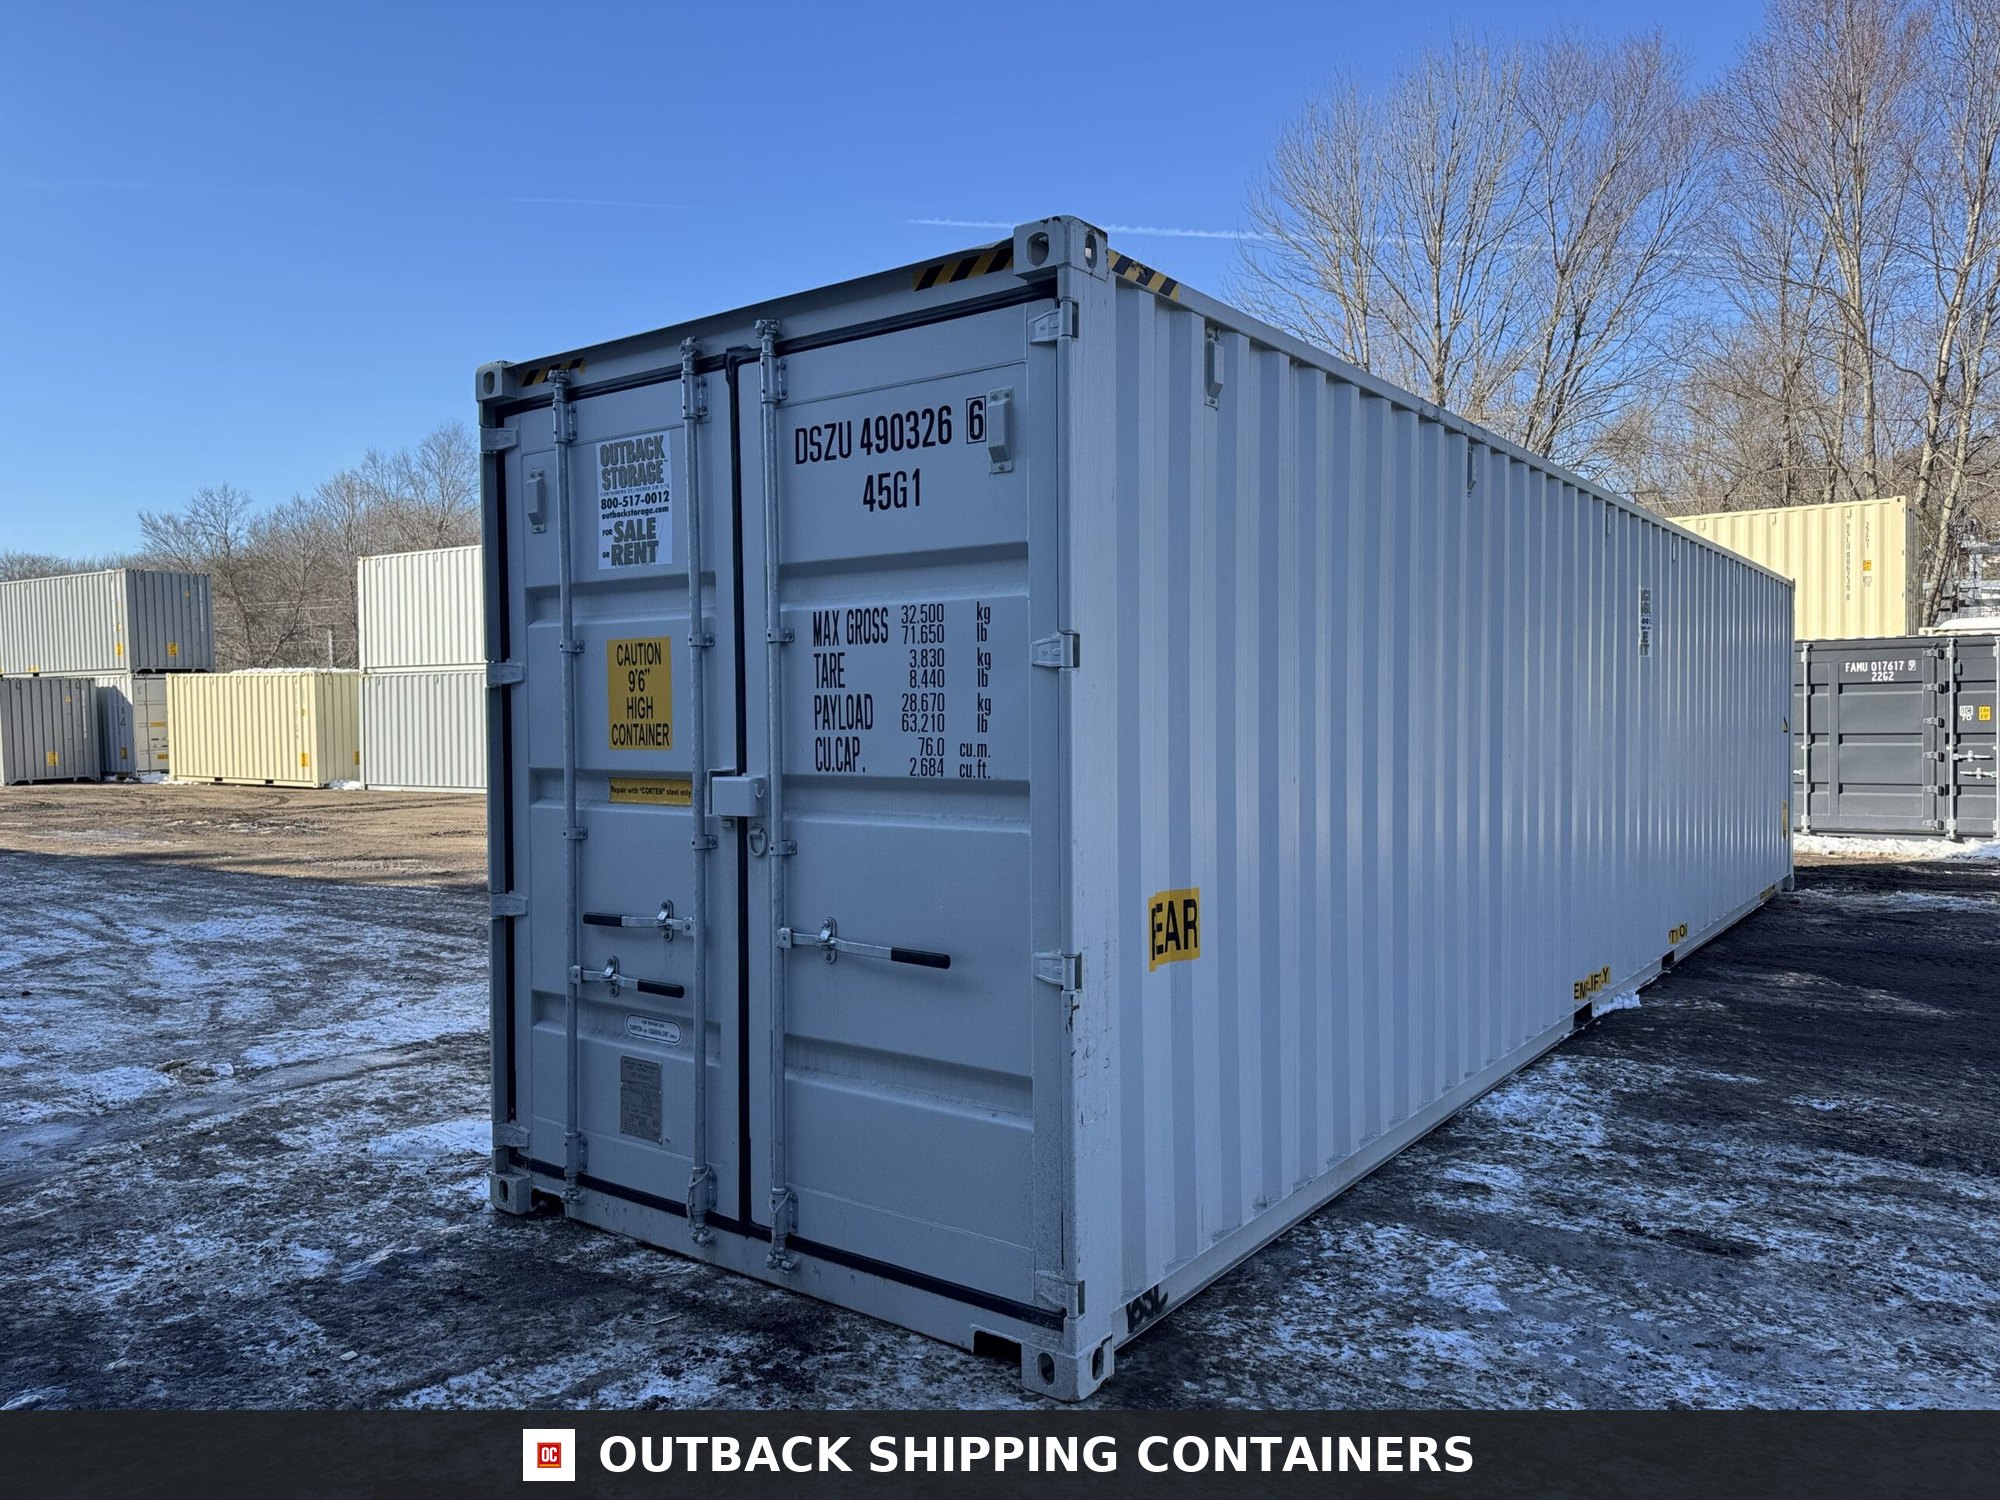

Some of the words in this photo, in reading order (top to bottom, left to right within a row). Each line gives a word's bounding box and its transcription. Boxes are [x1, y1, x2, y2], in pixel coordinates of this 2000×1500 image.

[795, 420, 852, 465] DSZU
[860, 404, 952, 456] 490326
[967, 397, 986, 443] 6
[600, 434, 665, 467] OUTBACK
[601, 459, 665, 491] STORAGE
[601, 490, 670, 510] 800-517-0012
[863, 468, 920, 512] 45G1
[601, 506, 669, 519] outbackstorage.com
[602, 528, 613, 536] FOR
[614, 517, 656, 543] SALE
[611, 540, 659, 566] RENT
[813, 610, 840, 647] MAX
[846, 606, 889, 645] GROSS
[901, 603, 944, 625] 32,500
[976, 601, 990, 624] kg
[976, 622, 987, 642] lb
[616, 642, 662, 666] CAUTION
[814, 652, 845, 689] TARE
[909, 648, 945, 668] 3,830
[977, 647, 991, 670] kg
[1845, 661, 1868, 672] FAMU
[1871, 660, 1905, 671] 017617
[1871, 671, 1894, 681] 22G2
[909, 669, 945, 689] 8,440
[977, 668, 988, 687] lb
[627, 696, 653, 719] HIGH
[814, 693, 873, 730] PAYLOAD
[901, 692, 945, 712] 28,670
[977, 692, 991, 716] kg
[611, 723, 670, 746] CONTAINER
[901, 713, 945, 733] 63,210
[977, 714, 988, 733] lb
[918, 737, 945, 757] 76.0
[959, 742, 991, 758] cu.m.
[909, 758, 944, 778] 2,684
[959, 759, 991, 779] cu.ft.
[611, 785, 627, 795] Repair
[666, 788, 680, 796] steel
[680, 789, 691, 798] only
